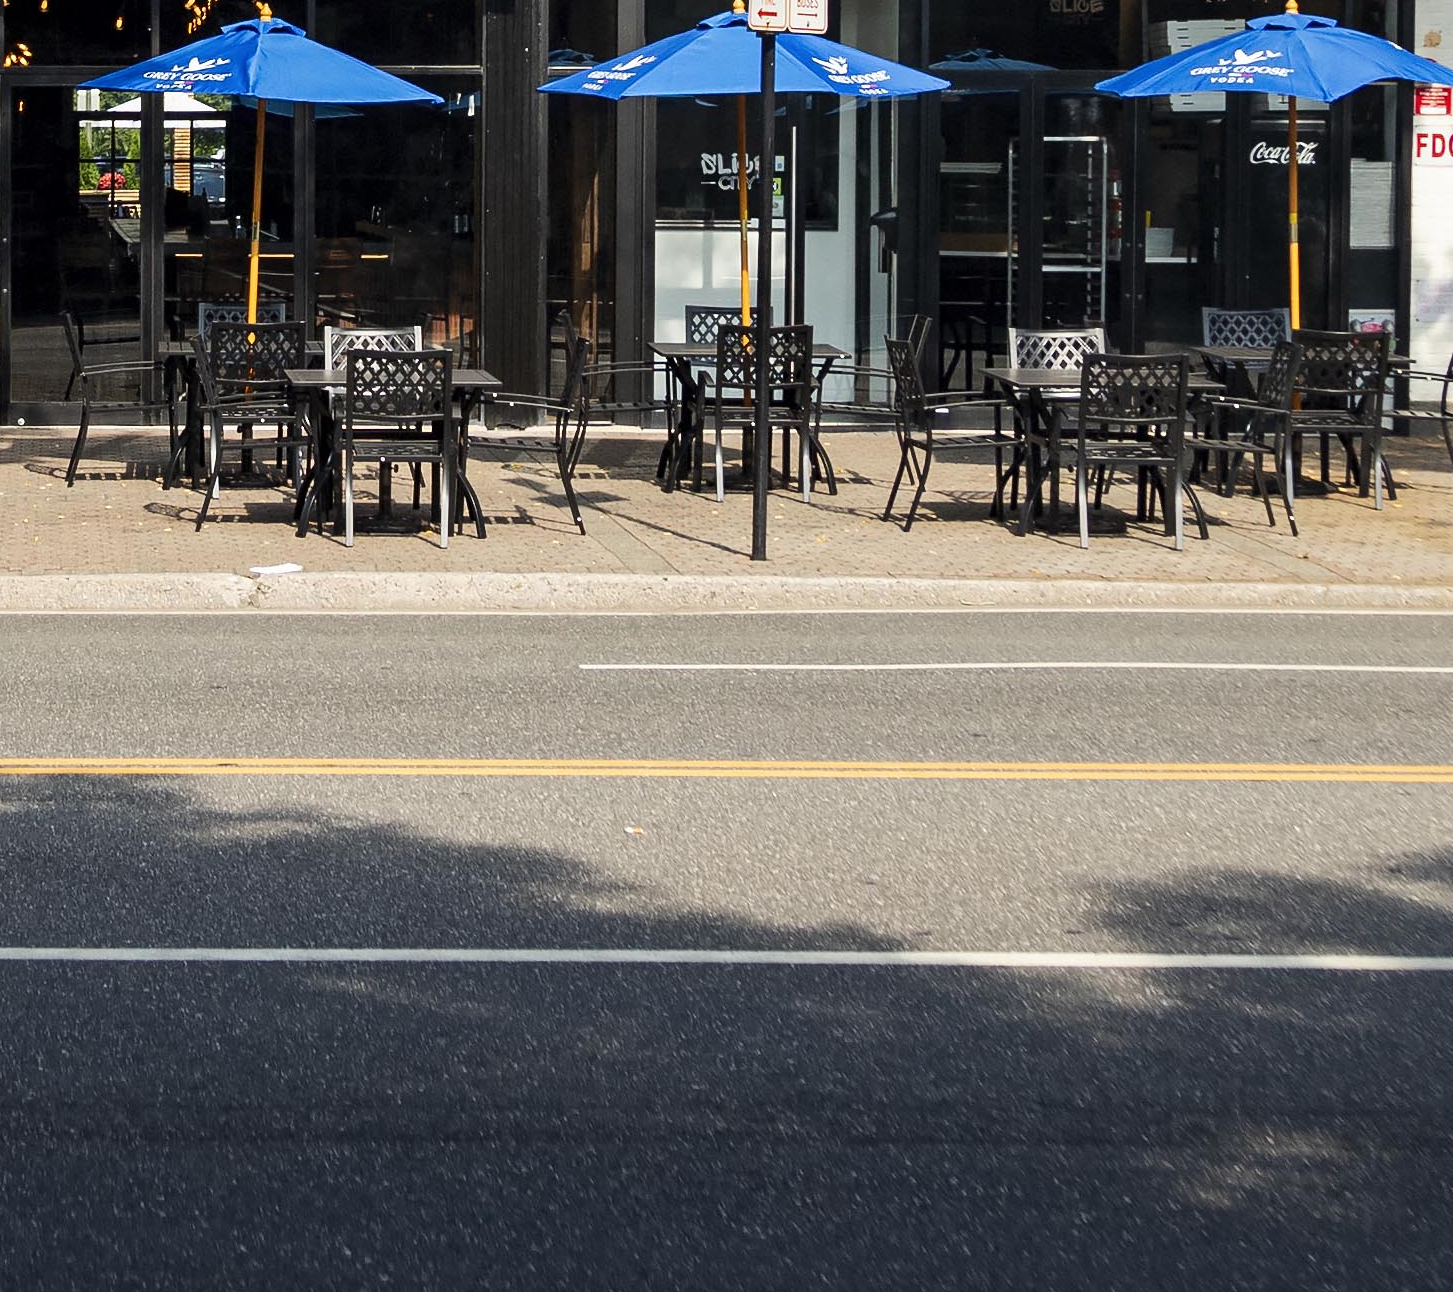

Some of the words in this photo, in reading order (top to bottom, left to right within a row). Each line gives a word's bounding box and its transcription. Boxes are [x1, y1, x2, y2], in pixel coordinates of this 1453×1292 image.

[1190, 67, 1232, 75] GREY
[1233, 66, 1288, 76] GOOSE
[143, 72, 181, 80] GREY
[181, 73, 226, 81] GOOSE
